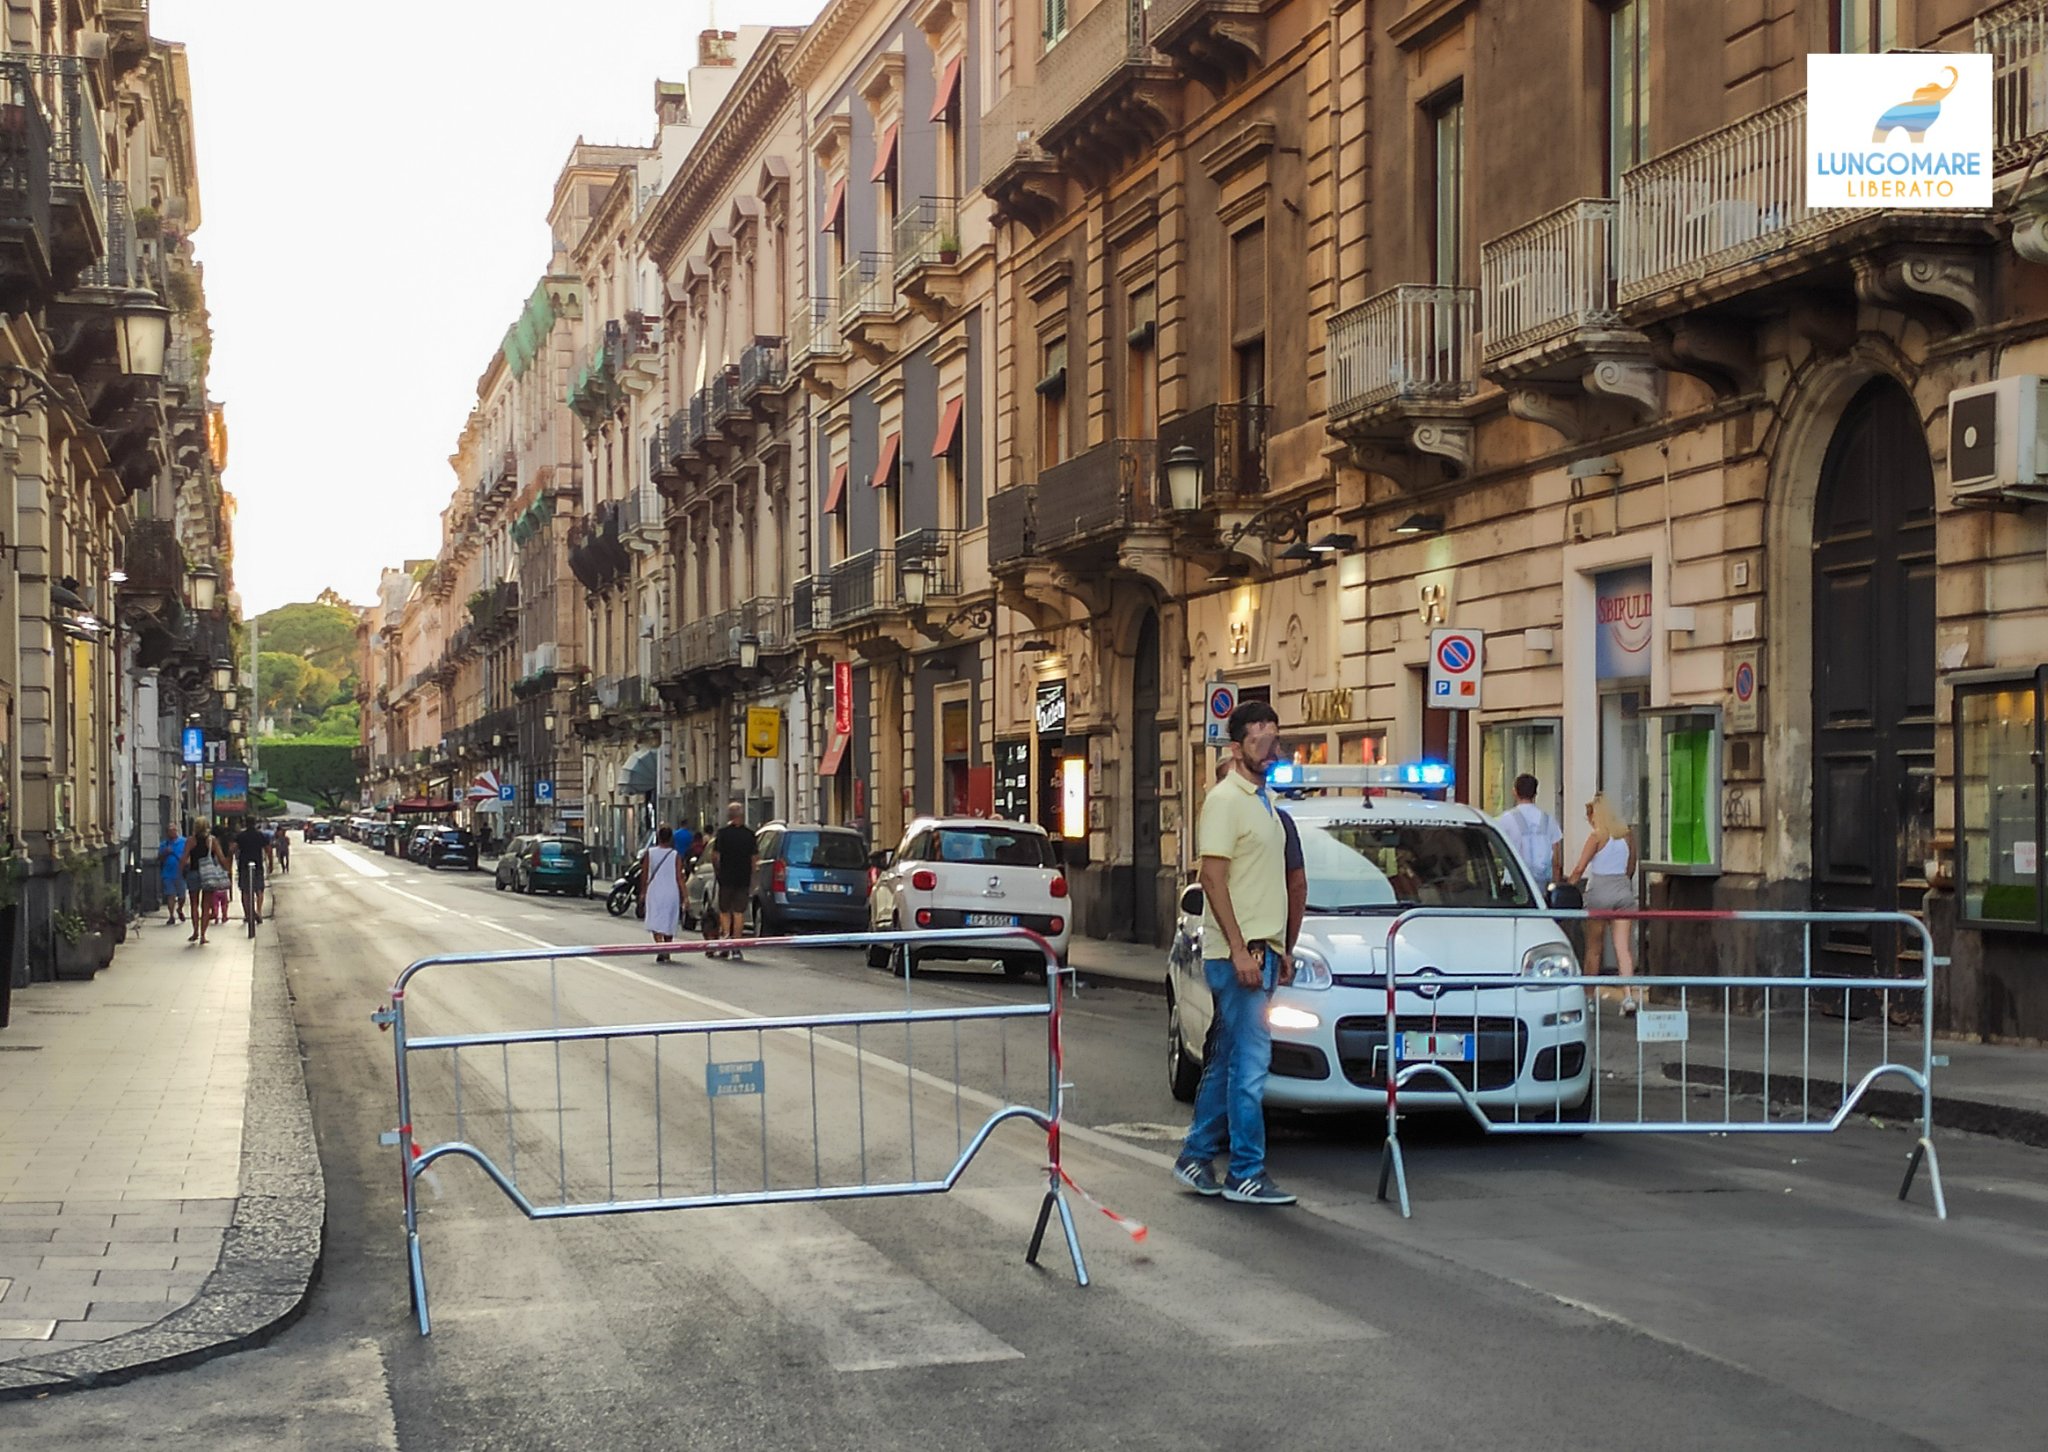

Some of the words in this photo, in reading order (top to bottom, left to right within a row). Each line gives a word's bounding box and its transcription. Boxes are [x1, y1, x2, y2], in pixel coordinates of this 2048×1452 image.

[1438, 682, 1448, 694] P
[501, 787, 511, 799] P
[539, 783, 549, 796] P
